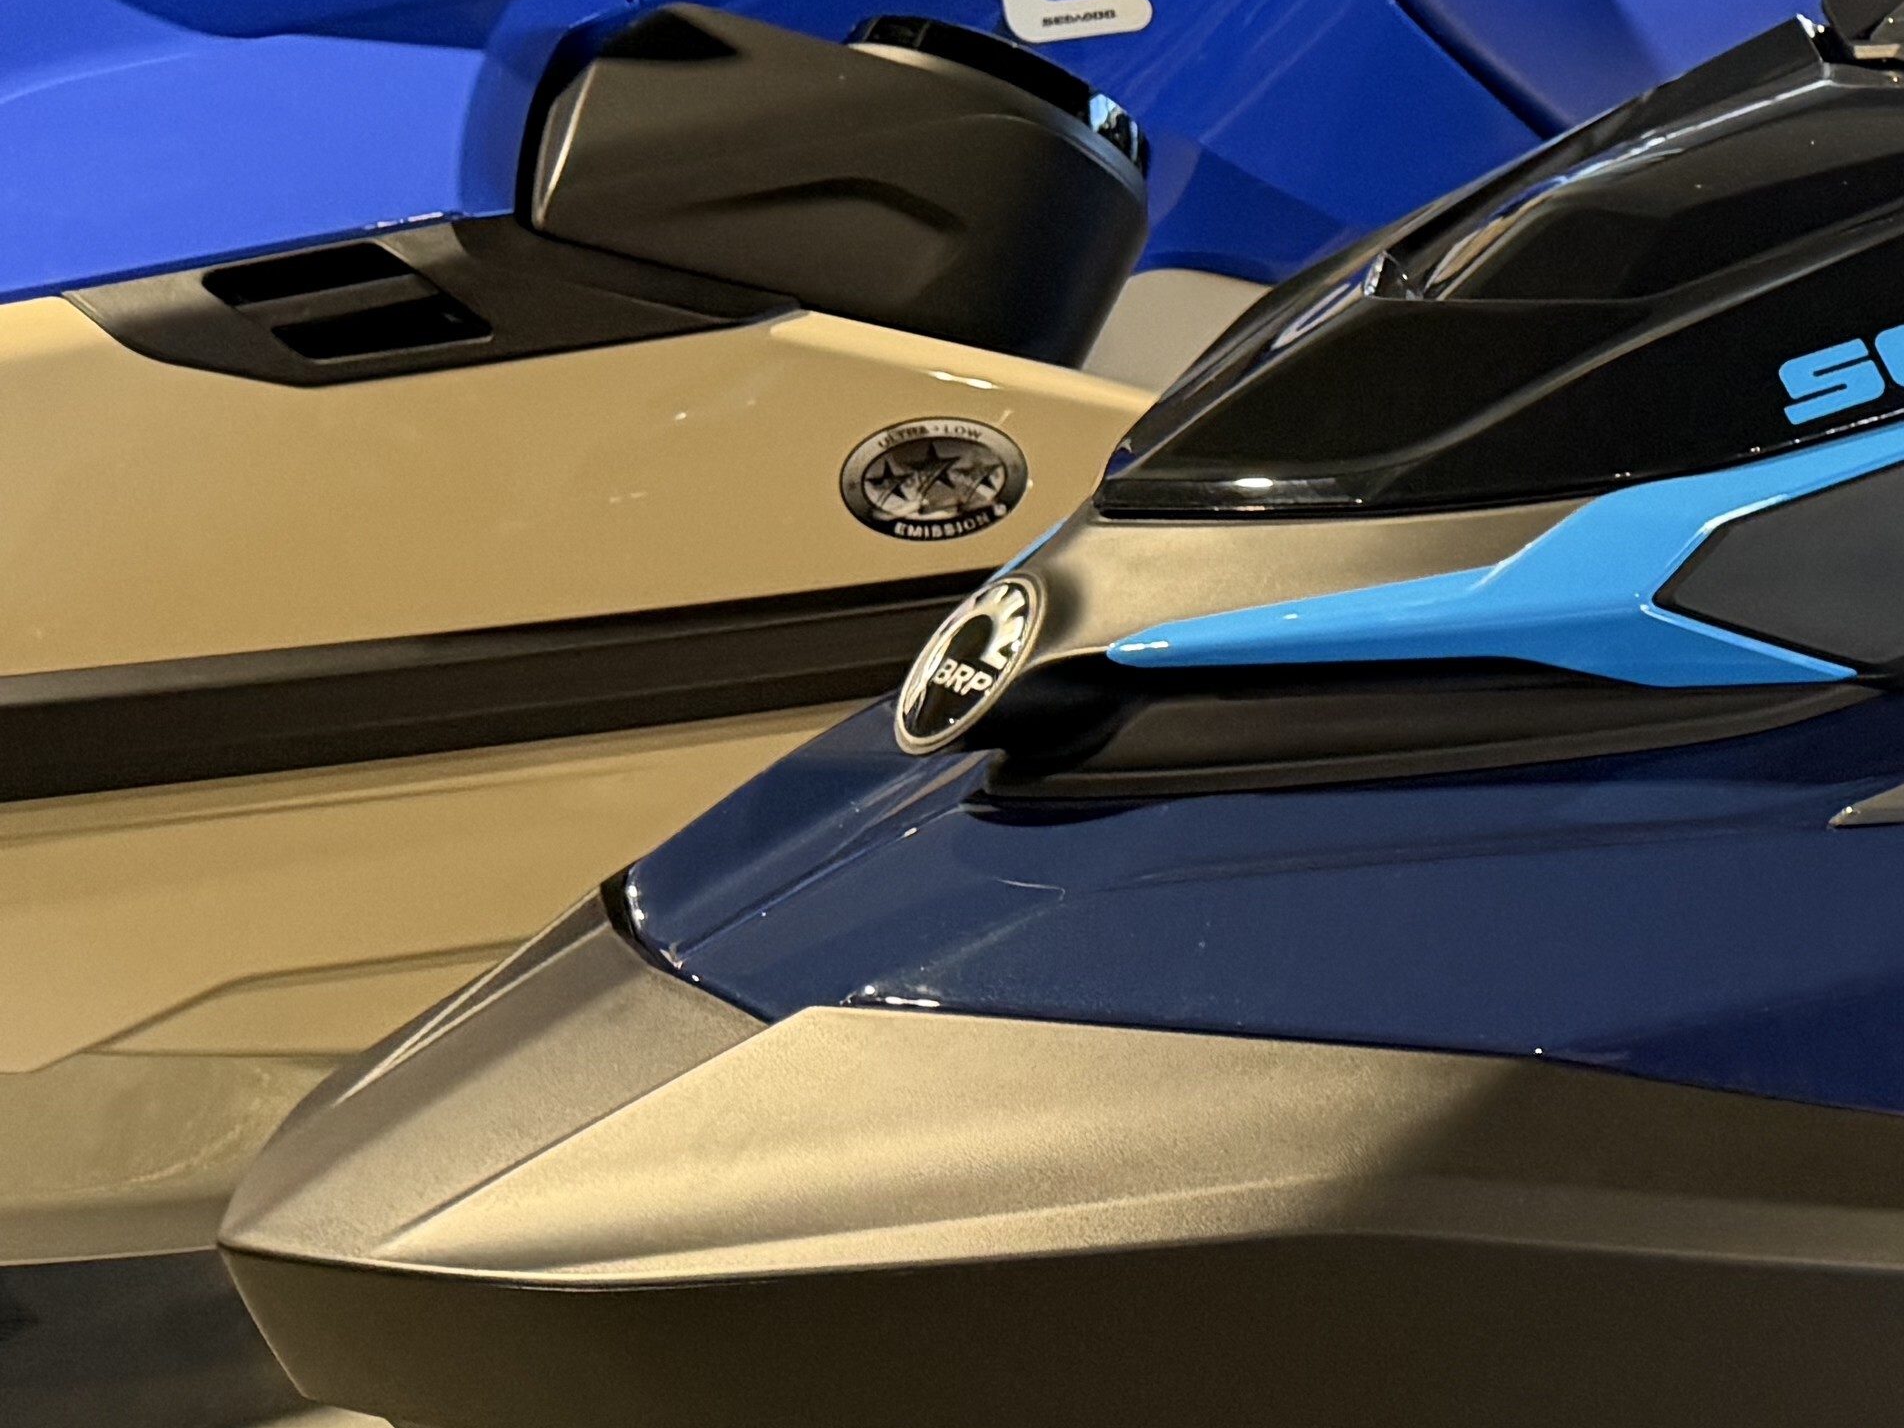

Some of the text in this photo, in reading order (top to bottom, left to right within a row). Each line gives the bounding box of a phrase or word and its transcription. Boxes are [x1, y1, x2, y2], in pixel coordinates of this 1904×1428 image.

[877, 424, 982, 448] ULTRA LOW
[894, 512, 990, 539] EMISSION
[931, 657, 994, 696] BRP
